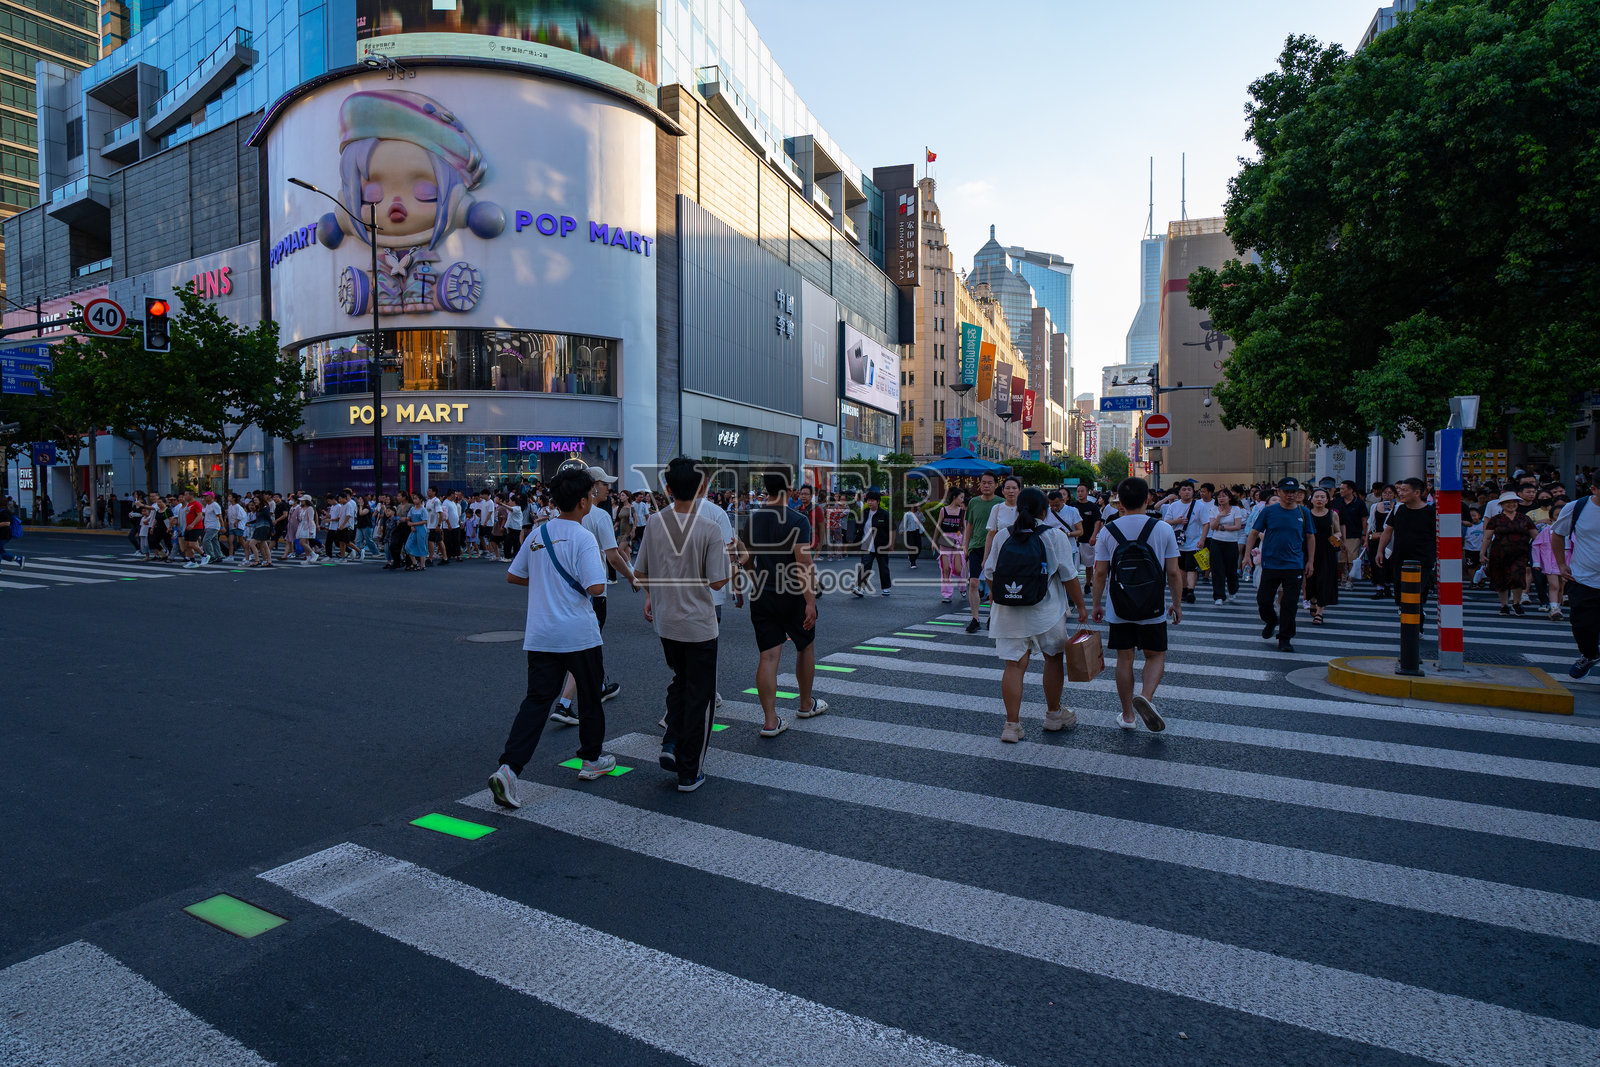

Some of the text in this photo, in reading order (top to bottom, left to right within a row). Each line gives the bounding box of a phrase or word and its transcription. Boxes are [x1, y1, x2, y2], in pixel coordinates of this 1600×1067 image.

[515, 210, 654, 257] POP MART
[906, 220, 915, 279] 宏伊国际广场
[92, 306, 118, 327] 40
[814, 340, 825, 368] GAP
[396, 403, 469, 423] MART
[841, 402, 859, 418] SAMSUNG
[519, 440, 585, 452] POP MART
[20, 469, 33, 478] FIVE
[20, 479, 33, 489] GUYS
